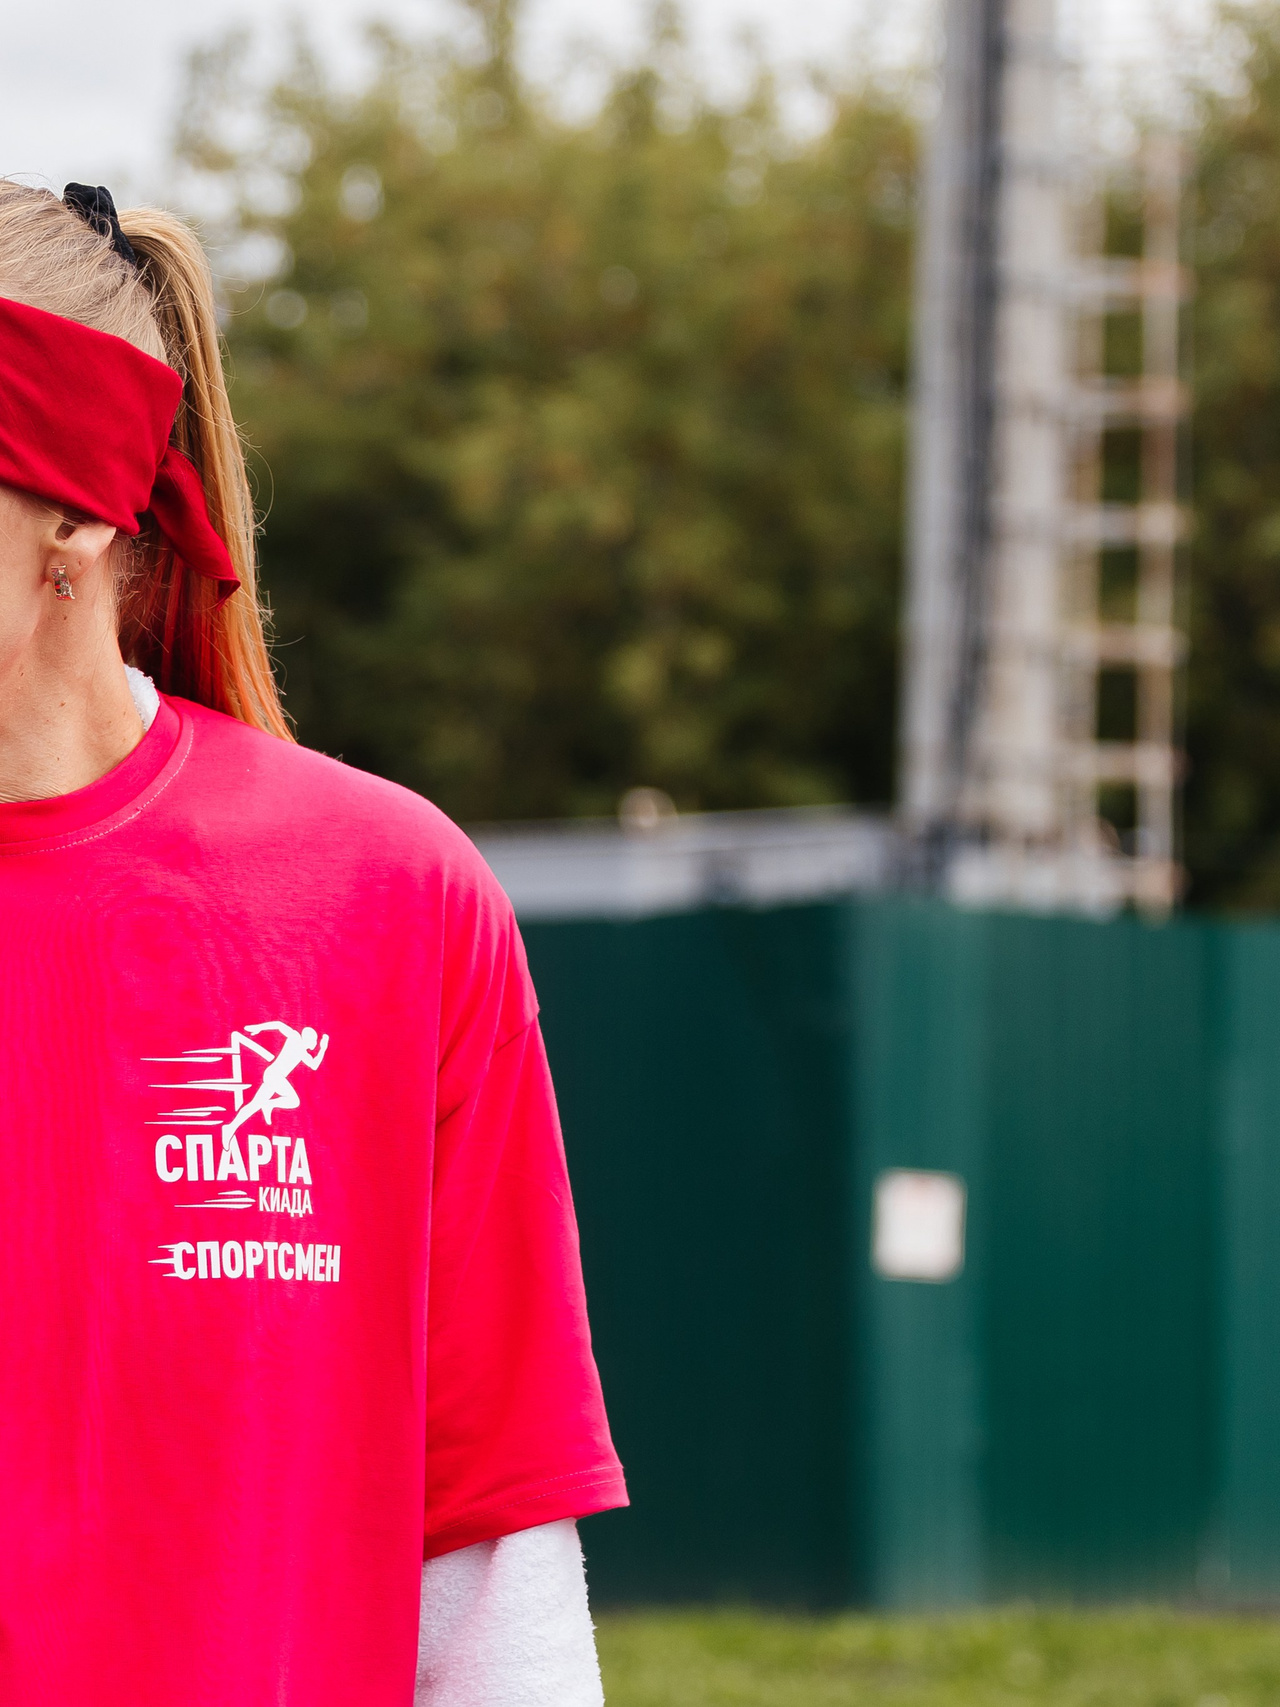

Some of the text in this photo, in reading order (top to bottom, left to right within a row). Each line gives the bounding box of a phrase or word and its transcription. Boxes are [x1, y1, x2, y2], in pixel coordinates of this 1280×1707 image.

[155, 1134, 313, 1185] СПАРТА
[259, 1187, 313, 1217] КИАДА
[173, 1241, 341, 1282] СПОРТСМЕН
